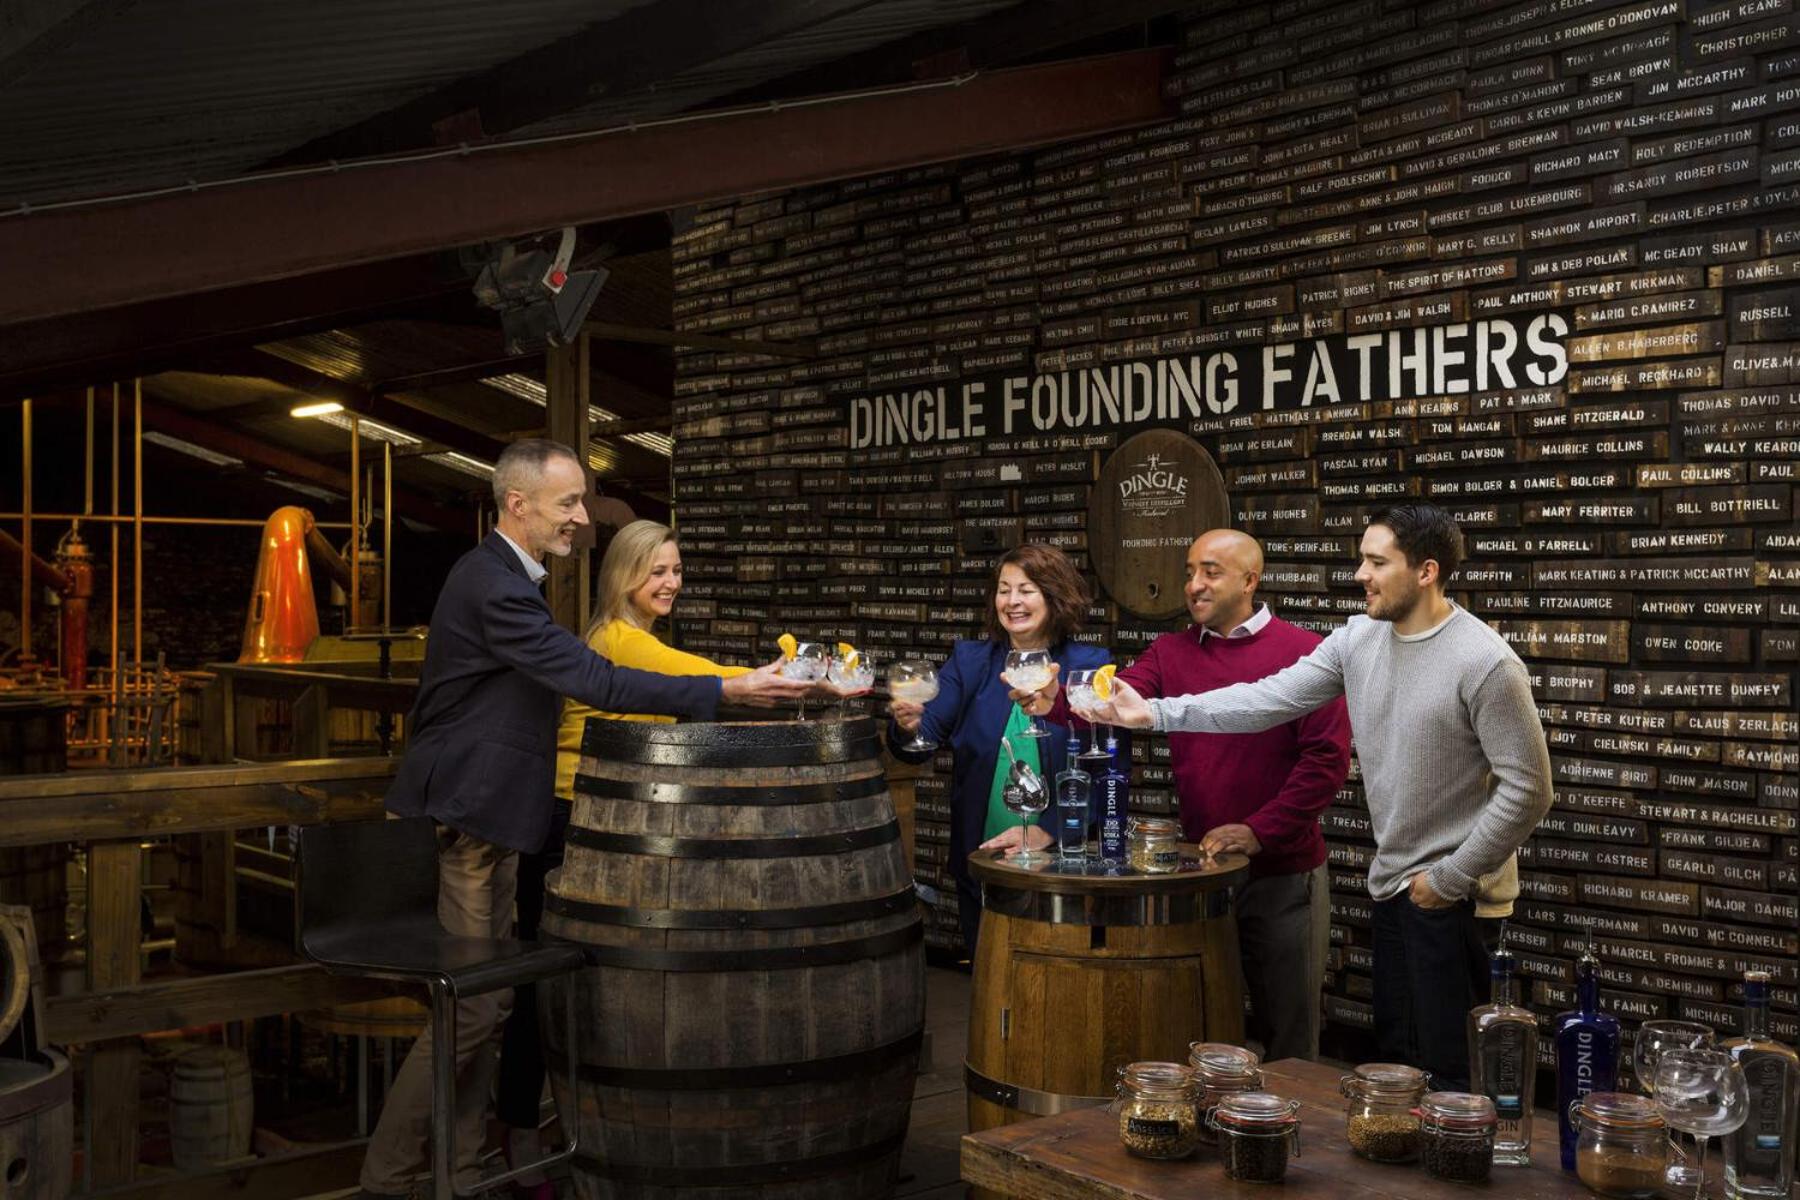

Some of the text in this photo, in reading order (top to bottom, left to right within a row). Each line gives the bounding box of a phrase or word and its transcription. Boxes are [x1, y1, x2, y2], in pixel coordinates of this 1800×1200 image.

[1698, 0, 1782, 27] HUGH KEANE
[1700, 26, 1788, 55] CHRISTOPHER
[1591, 58, 1672, 87] SEAN BROWN
[1648, 67, 1747, 96] JIM MCCARTHY
[1489, 114, 1524, 130] CAROL
[1536, 103, 1570, 119] KEVIN
[1578, 91, 1622, 109] BARDEN
[1730, 94, 1767, 112] MARK
[1636, 128, 1752, 160] HOLY REDEMPTION
[1406, 161, 1435, 174] DAVID
[1446, 145, 1501, 165] GERALDINE
[1507, 131, 1558, 150] BRENNAN
[1534, 148, 1620, 174] RICHARD MACY
[1424, 181, 1455, 194] HAIGH
[1430, 188, 1582, 225] WHISKEY CLUB LUXEMBOURG
[1366, 218, 1419, 235] JIM LYNCH
[1736, 264, 1784, 280] DANIEL
[1388, 281, 1407, 290] THE
[1409, 274, 1439, 288] SPIRIT
[1442, 273, 1454, 283] OF
[1303, 290, 1338, 303] PATRICK
[1478, 273, 1686, 309] PAUL ANTHONY STEWART KIRKMAN
[1355, 303, 1450, 325] DAVID & JIM WALSH
[1740, 306, 1792, 322] RUSSELL
[850, 314, 1569, 449] DINGLE FOUNDING FATHERS
[1480, 393, 1552, 408] PAT & MARK
[1682, 394, 1781, 412] THOMAS DAVID
[1394, 402, 1458, 417] ANN KEARNS
[1194, 416, 1253, 432] CATHAL FRIEL
[1533, 410, 1645, 427] SHANE FITZGERALD
[1323, 428, 1400, 442] BRENDAN WALSH
[1541, 440, 1644, 455] MAURICE COLLINS
[1704, 441, 1746, 454] WALLY
[1323, 457, 1388, 471] PASCAL RYAN
[1416, 448, 1505, 464] MICHAEL DAWSON
[1642, 467, 1733, 481] PAUL COLLINS
[1760, 464, 1794, 477] PAUL
[1119, 471, 1188, 498] DINGLE
[1324, 482, 1405, 495] THOMAS MICHELS
[1432, 475, 1615, 493] SIMON BOLGER & DANIEL BOLGER
[1541, 505, 1634, 518] MARY FERRITER
[1676, 498, 1779, 514] BILL BOTTRIELL
[1238, 509, 1307, 521] OLIVER HUGHES
[1324, 517, 1352, 527] ALLAN
[1454, 511, 1494, 522] CLARKE
[1160, 537, 1193, 547] FATHERS
[1631, 533, 1726, 549] BRIAN KENNEDY
[1277, 573, 1319, 582] HUBBARD
[1467, 570, 1512, 581] GRIFFITH
[1539, 567, 1750, 581] MARK KEATING & PATRICK MCCARTHY
[1487, 597, 1613, 609] PAULINE FITZMAURICE
[1642, 602, 1762, 616] ANTHONY CONVERY
[1645, 637, 1723, 653] OWEN COOKE
[1550, 676, 1593, 689] BROPHY
[1614, 683, 1781, 697] BOB & JEANETTE DUNFEY
[1576, 711, 1611, 725] PETER
[1619, 714, 1666, 729] KUTNER
[1555, 731, 1577, 744] JOY
[1593, 738, 1703, 757] CIELINSKI FAMILY
[1665, 773, 1748, 792] JOHN MASON
[1107, 779, 1116, 816] DINGLE
[1332, 817, 1370, 830] TREACY
[1639, 806, 1777, 828] STEWART & RACHELLE
[1573, 822, 1635, 838] DUNLEAVY
[1540, 847, 1649, 869] STEPHEN CASTREE
[1583, 883, 1690, 905] RICHARD KRAMER
[1705, 897, 1746, 913] MAJOR
[1527, 909, 1640, 933] LARS ZIMMERMANN
[1662, 922, 1786, 950] DAVID MC CONNELL
[1522, 959, 1566, 978] CURRAN
[1548, 989, 1659, 1017] THE FAMILY
[1685, 1006, 1737, 1028] MICHAEL
[1577, 1032, 1593, 1097] DINGLE
